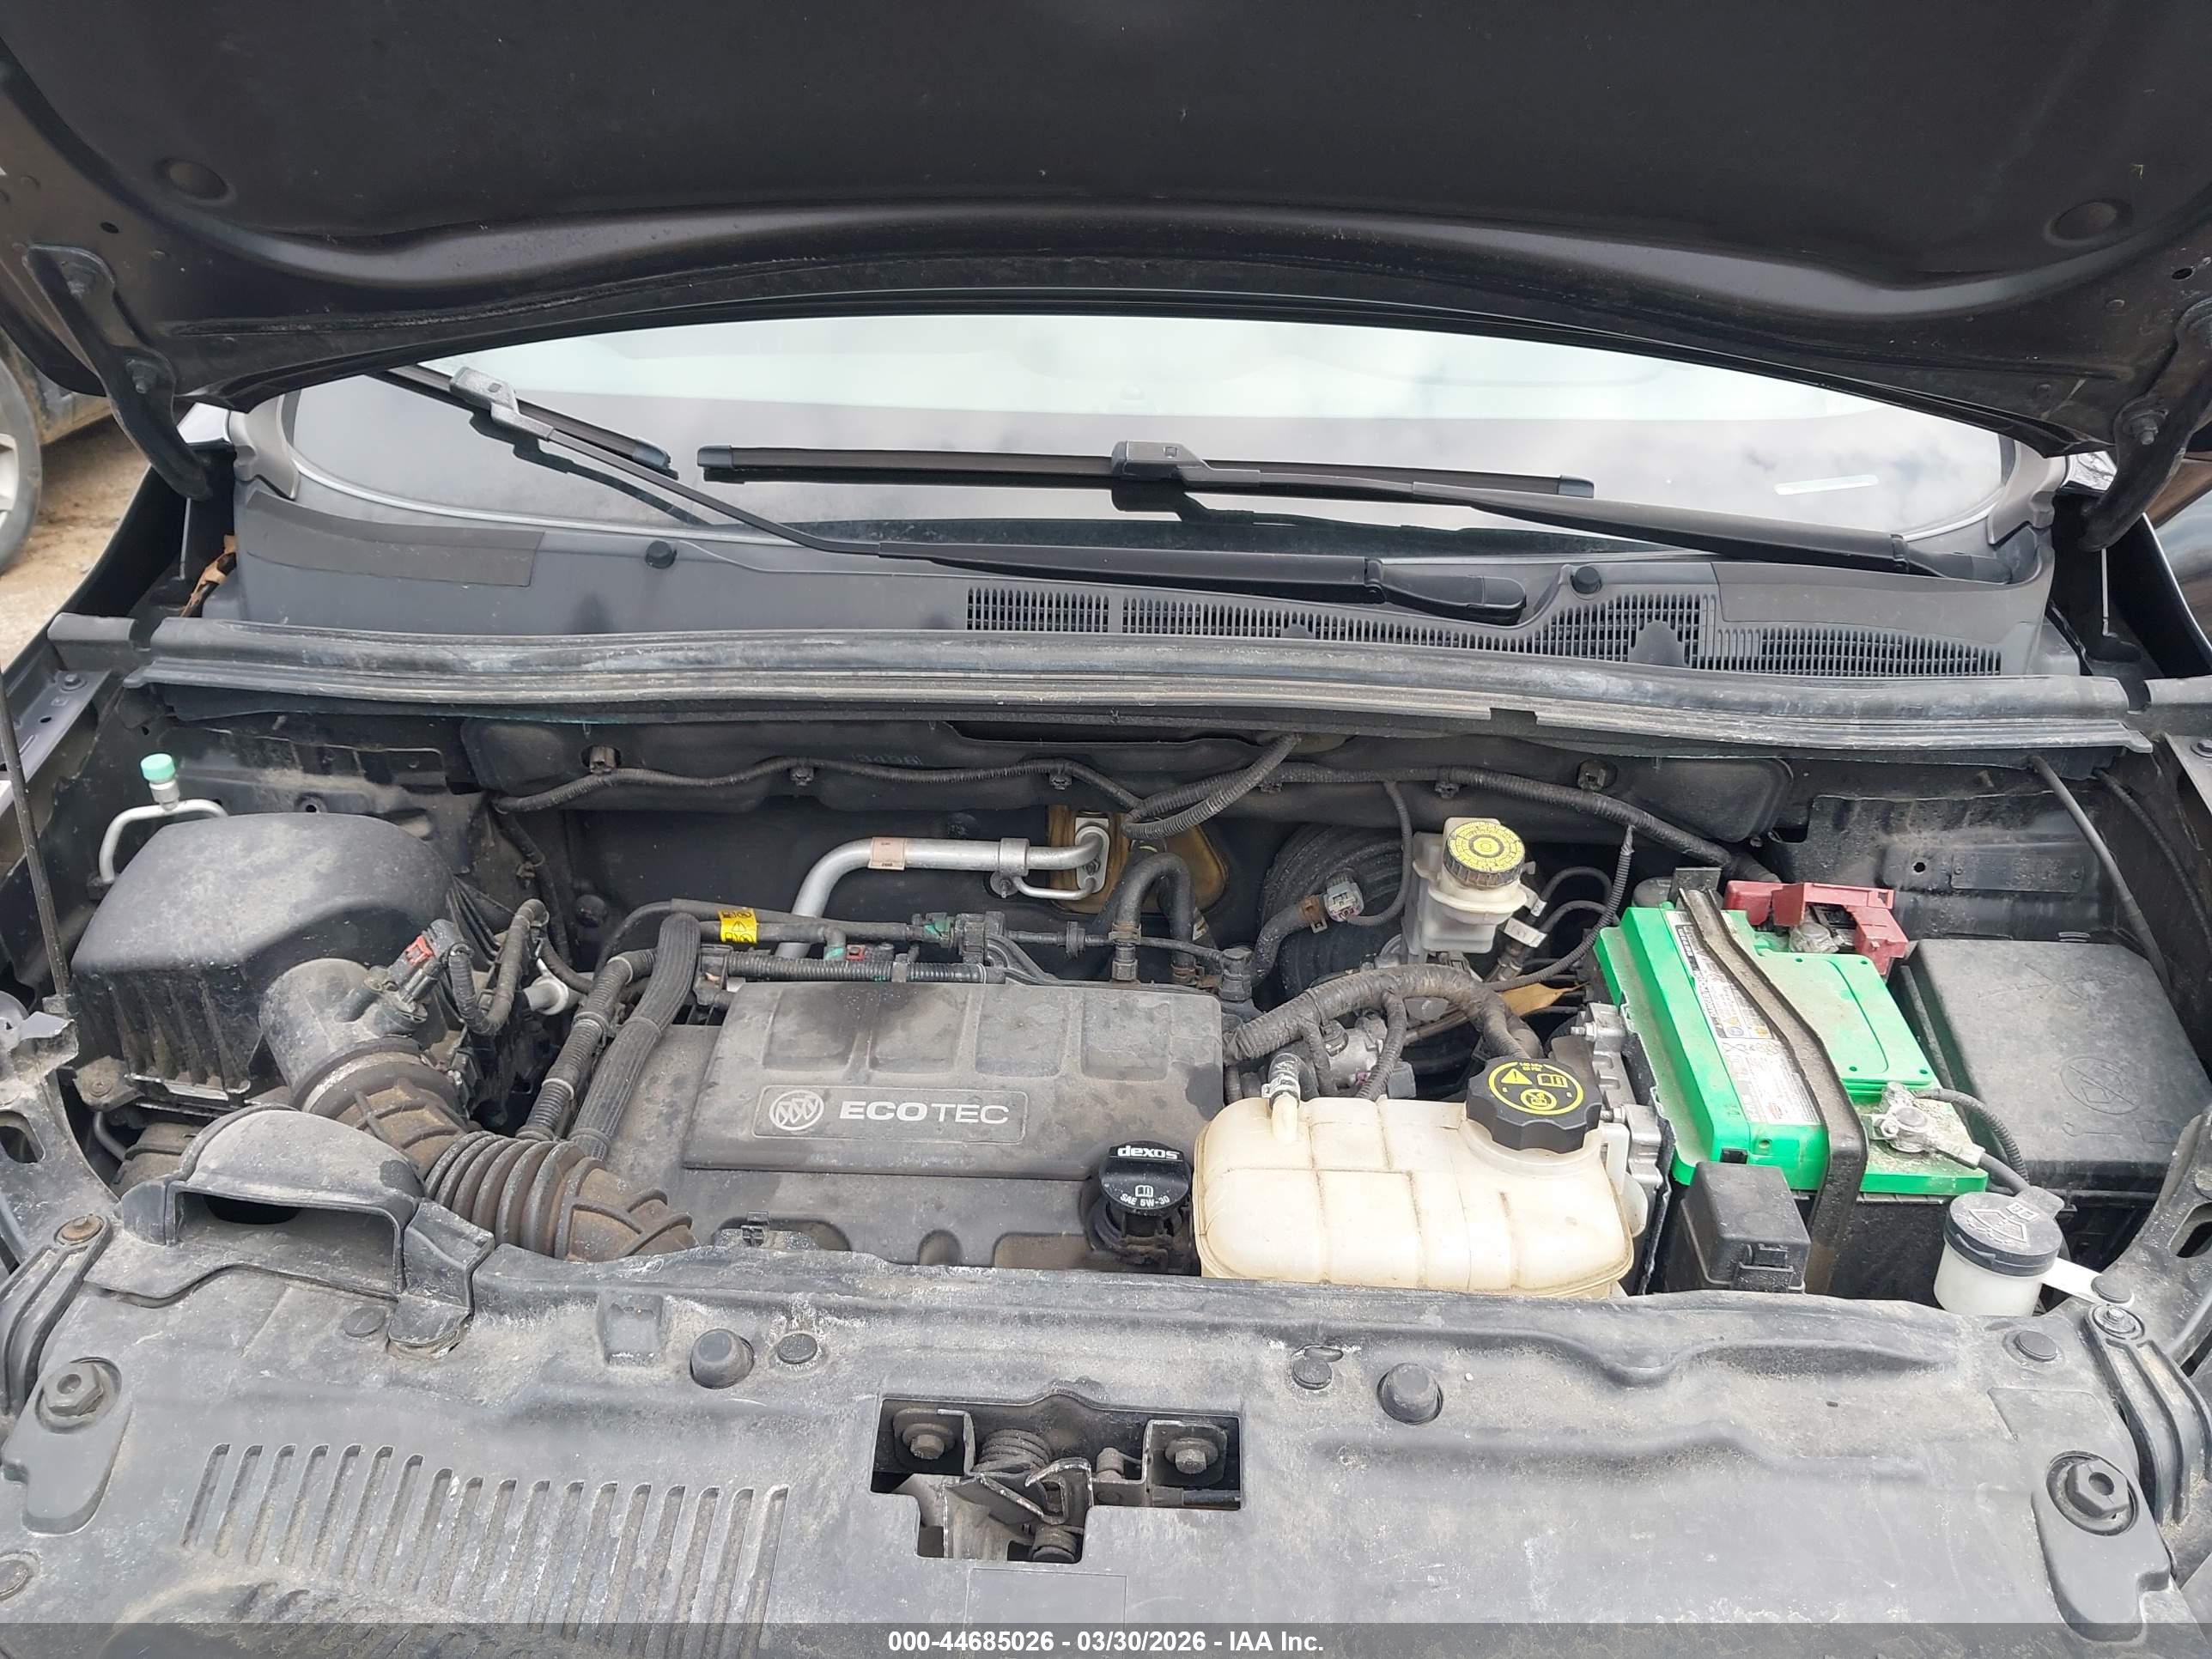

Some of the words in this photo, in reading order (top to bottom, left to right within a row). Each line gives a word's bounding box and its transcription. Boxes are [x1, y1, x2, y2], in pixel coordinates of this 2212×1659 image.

[839, 1101, 1009, 1124] ECOTEC
[1117, 1146, 1181, 1160] dexos
[1120, 1193, 1138, 1206] SAE
[1139, 1195, 1170, 1207] 5W-30
